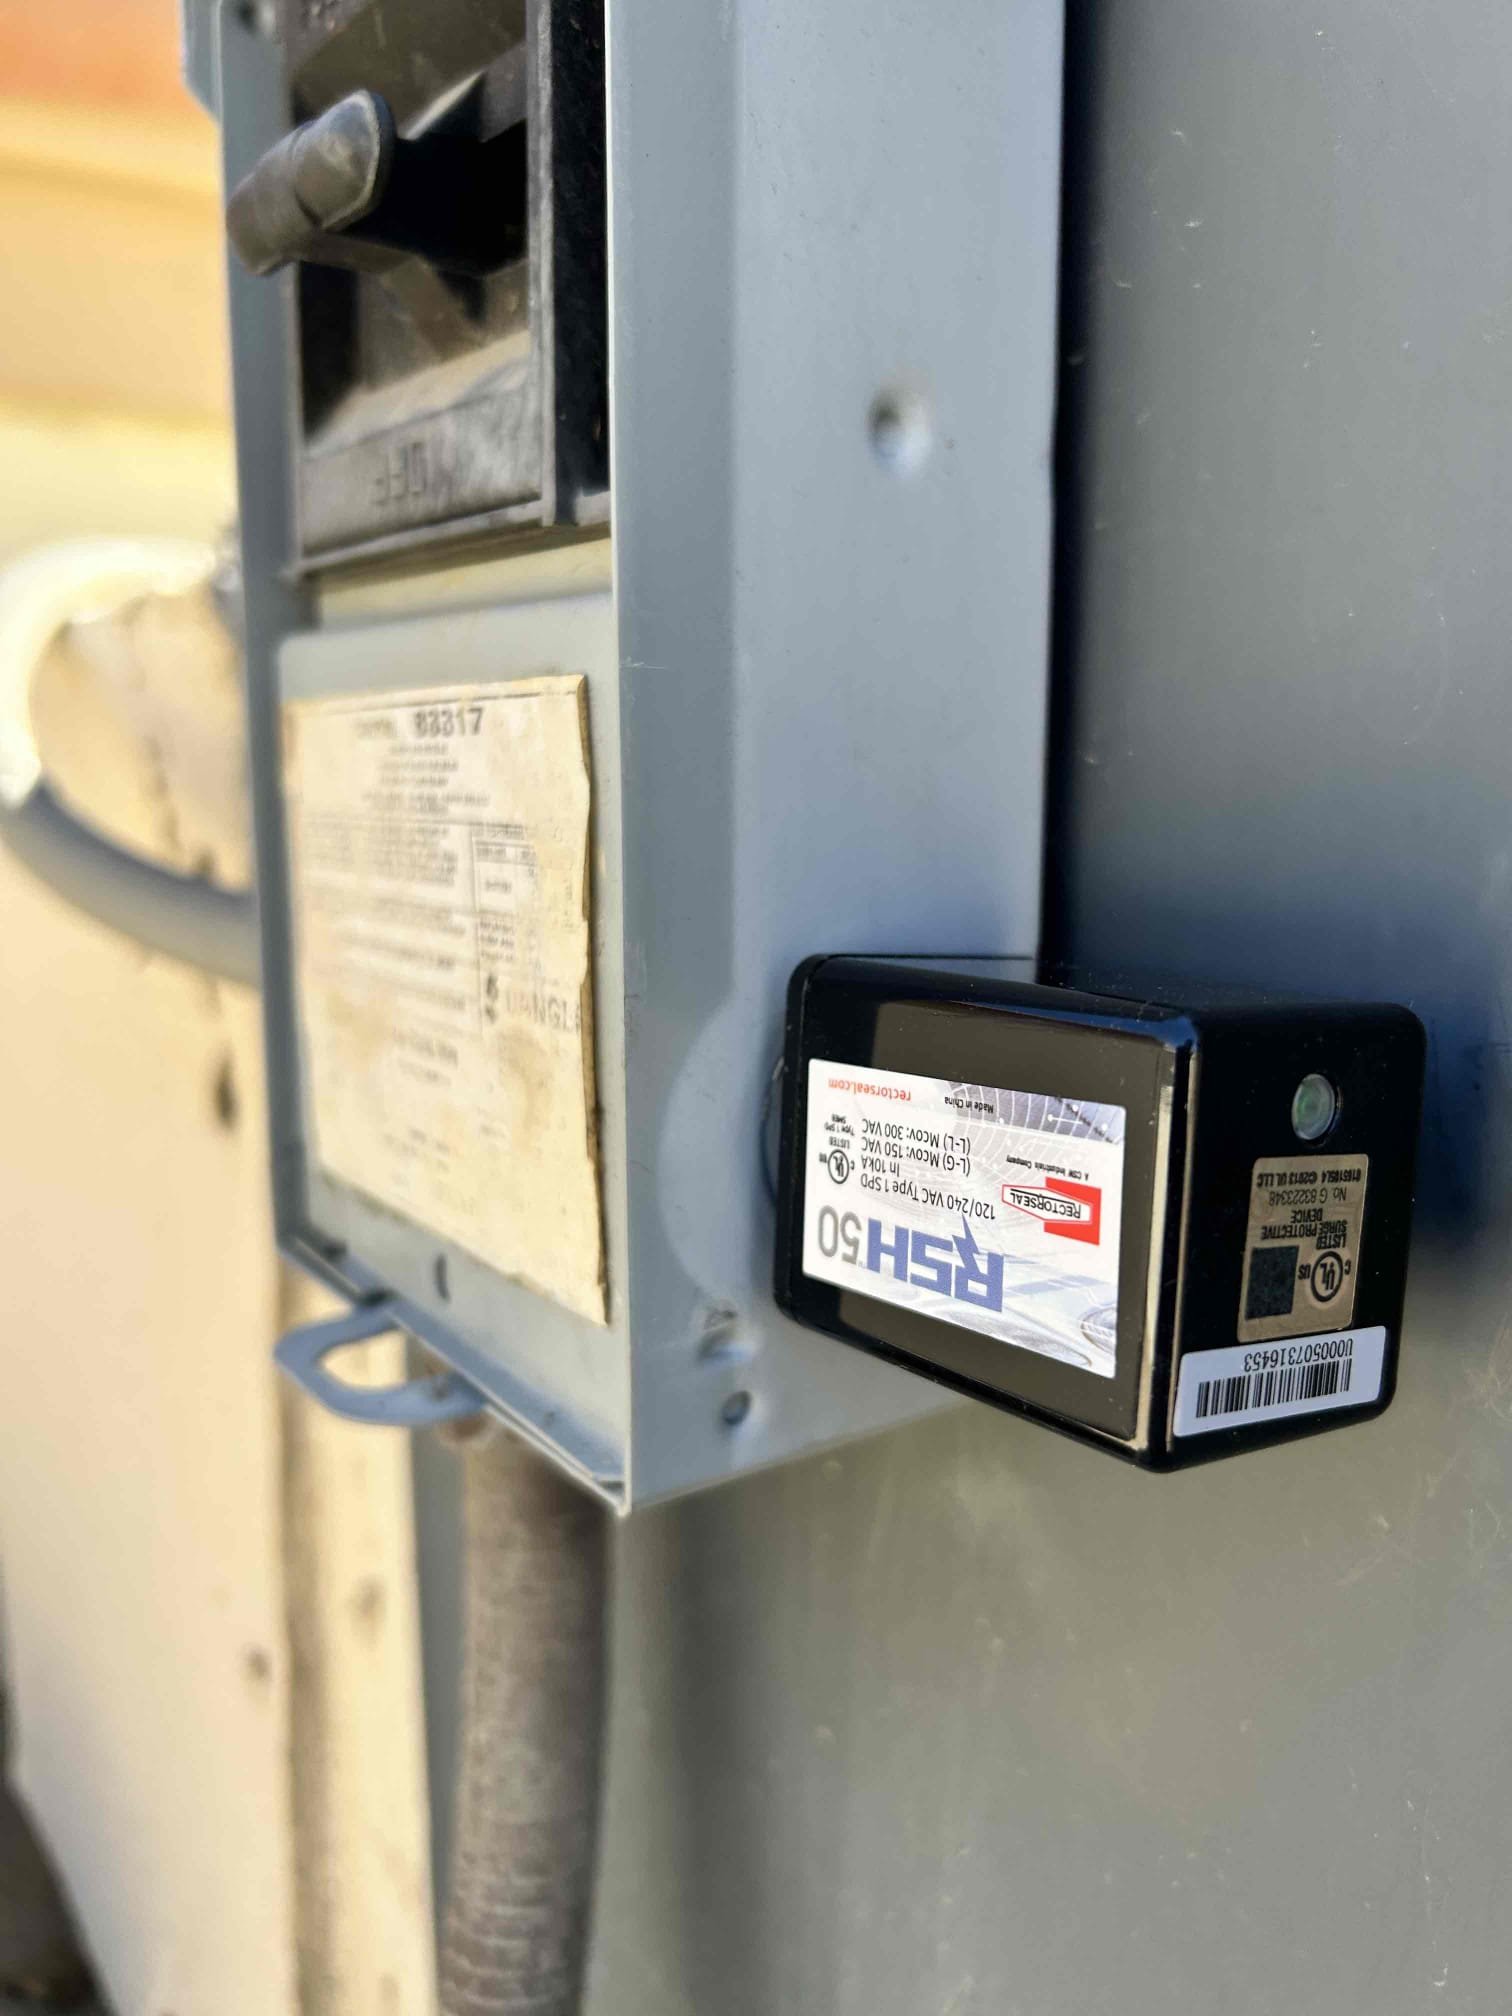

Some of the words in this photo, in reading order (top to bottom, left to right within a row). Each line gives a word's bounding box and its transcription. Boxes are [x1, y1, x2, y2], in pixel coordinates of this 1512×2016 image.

[827, 1079, 911, 1102] rectorseal.com
[944, 1096, 964, 1108] China
[965, 1101, 972, 1109] in
[974, 1101, 994, 1113] Made
[862, 1118, 882, 1136] VAC
[885, 1123, 904, 1140] 300
[861, 1136, 882, 1155] VAC
[906, 1127, 940, 1148] Mcov:
[944, 1133, 971, 1156] (L-L)
[884, 1141, 903, 1159] 150
[906, 1146, 940, 1168] Mcov:
[861, 1154, 886, 1174] 10kA
[889, 1161, 900, 1178] In
[943, 1153, 971, 1178] (L-G)
[1006, 1155, 1032, 1169] Company
[1035, 1161, 1066, 1176] Industrials
[860, 1173, 882, 1192] SPD
[885, 1178, 889, 1193] 1
[1256, 1173, 1274, 1188] LLC
[892, 1179, 919, 1202] Type
[922, 1188, 944, 1208] VAC
[1319, 1188, 1327, 1204] G
[947, 1195, 995, 1220] 120/240
[1010, 1191, 1081, 1219] RECTORSEAL
[1291, 1208, 1323, 1223] DEVICE
[818, 1205, 861, 1264] 50
[1261, 1223, 1317, 1240] PROTECTIVE
[1319, 1219, 1347, 1234] SURGE
[1316, 1233, 1346, 1250] LISTED
[867, 1216, 1004, 1312] RSH
[1298, 1264, 1311, 1279] US
[1244, 1338, 1353, 1372] U000507316453
